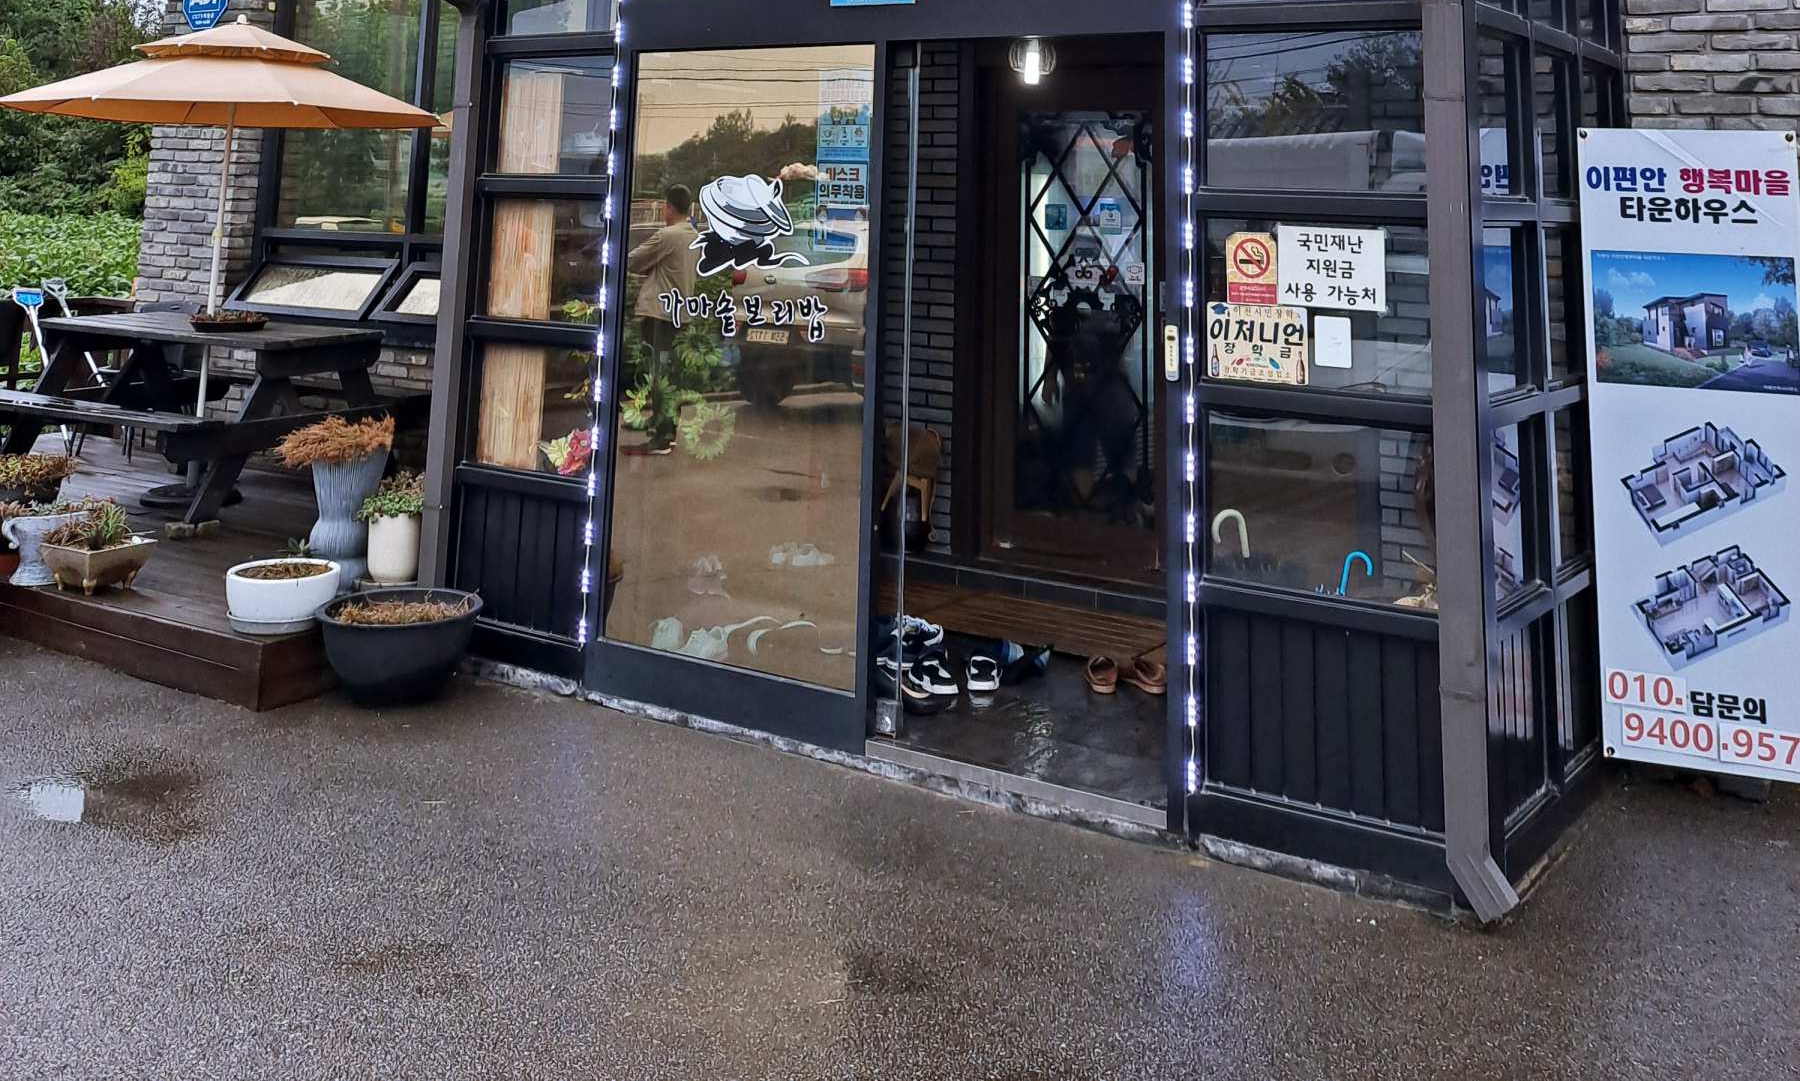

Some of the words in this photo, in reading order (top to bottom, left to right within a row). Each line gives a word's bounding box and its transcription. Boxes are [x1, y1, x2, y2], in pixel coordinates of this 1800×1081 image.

[819, 184, 865, 199] 의무착용
[1586, 166, 1667, 193] 이편안
[1679, 168, 1790, 196] 행복마을
[1620, 197, 1758, 224] 타운하우스
[1297, 233, 1364, 254] 국민재난
[1306, 258, 1355, 279] 지원금
[1285, 282, 1317, 302] 사용
[1327, 285, 1376, 306] 가능처
[658, 288, 828, 343] 가마솥보리밥
[1210, 318, 1304, 346] 이처니언
[1690, 690, 1767, 724] 담문의
